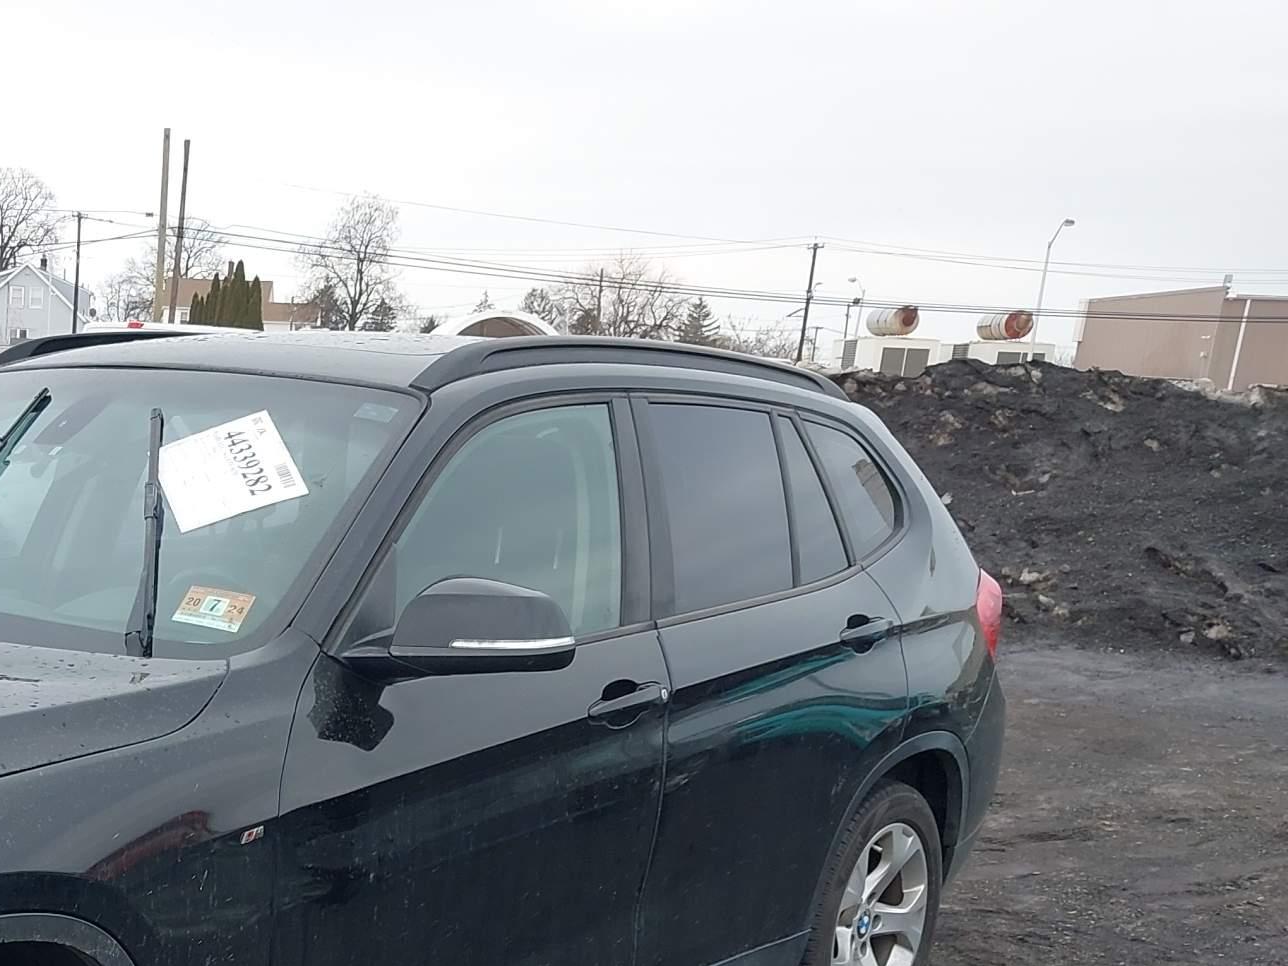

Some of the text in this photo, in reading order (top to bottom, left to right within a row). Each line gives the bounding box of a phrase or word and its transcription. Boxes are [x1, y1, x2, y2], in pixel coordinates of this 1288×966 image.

[223, 430, 273, 497] 44339282
[185, 596, 245, 615] 20 7 24
